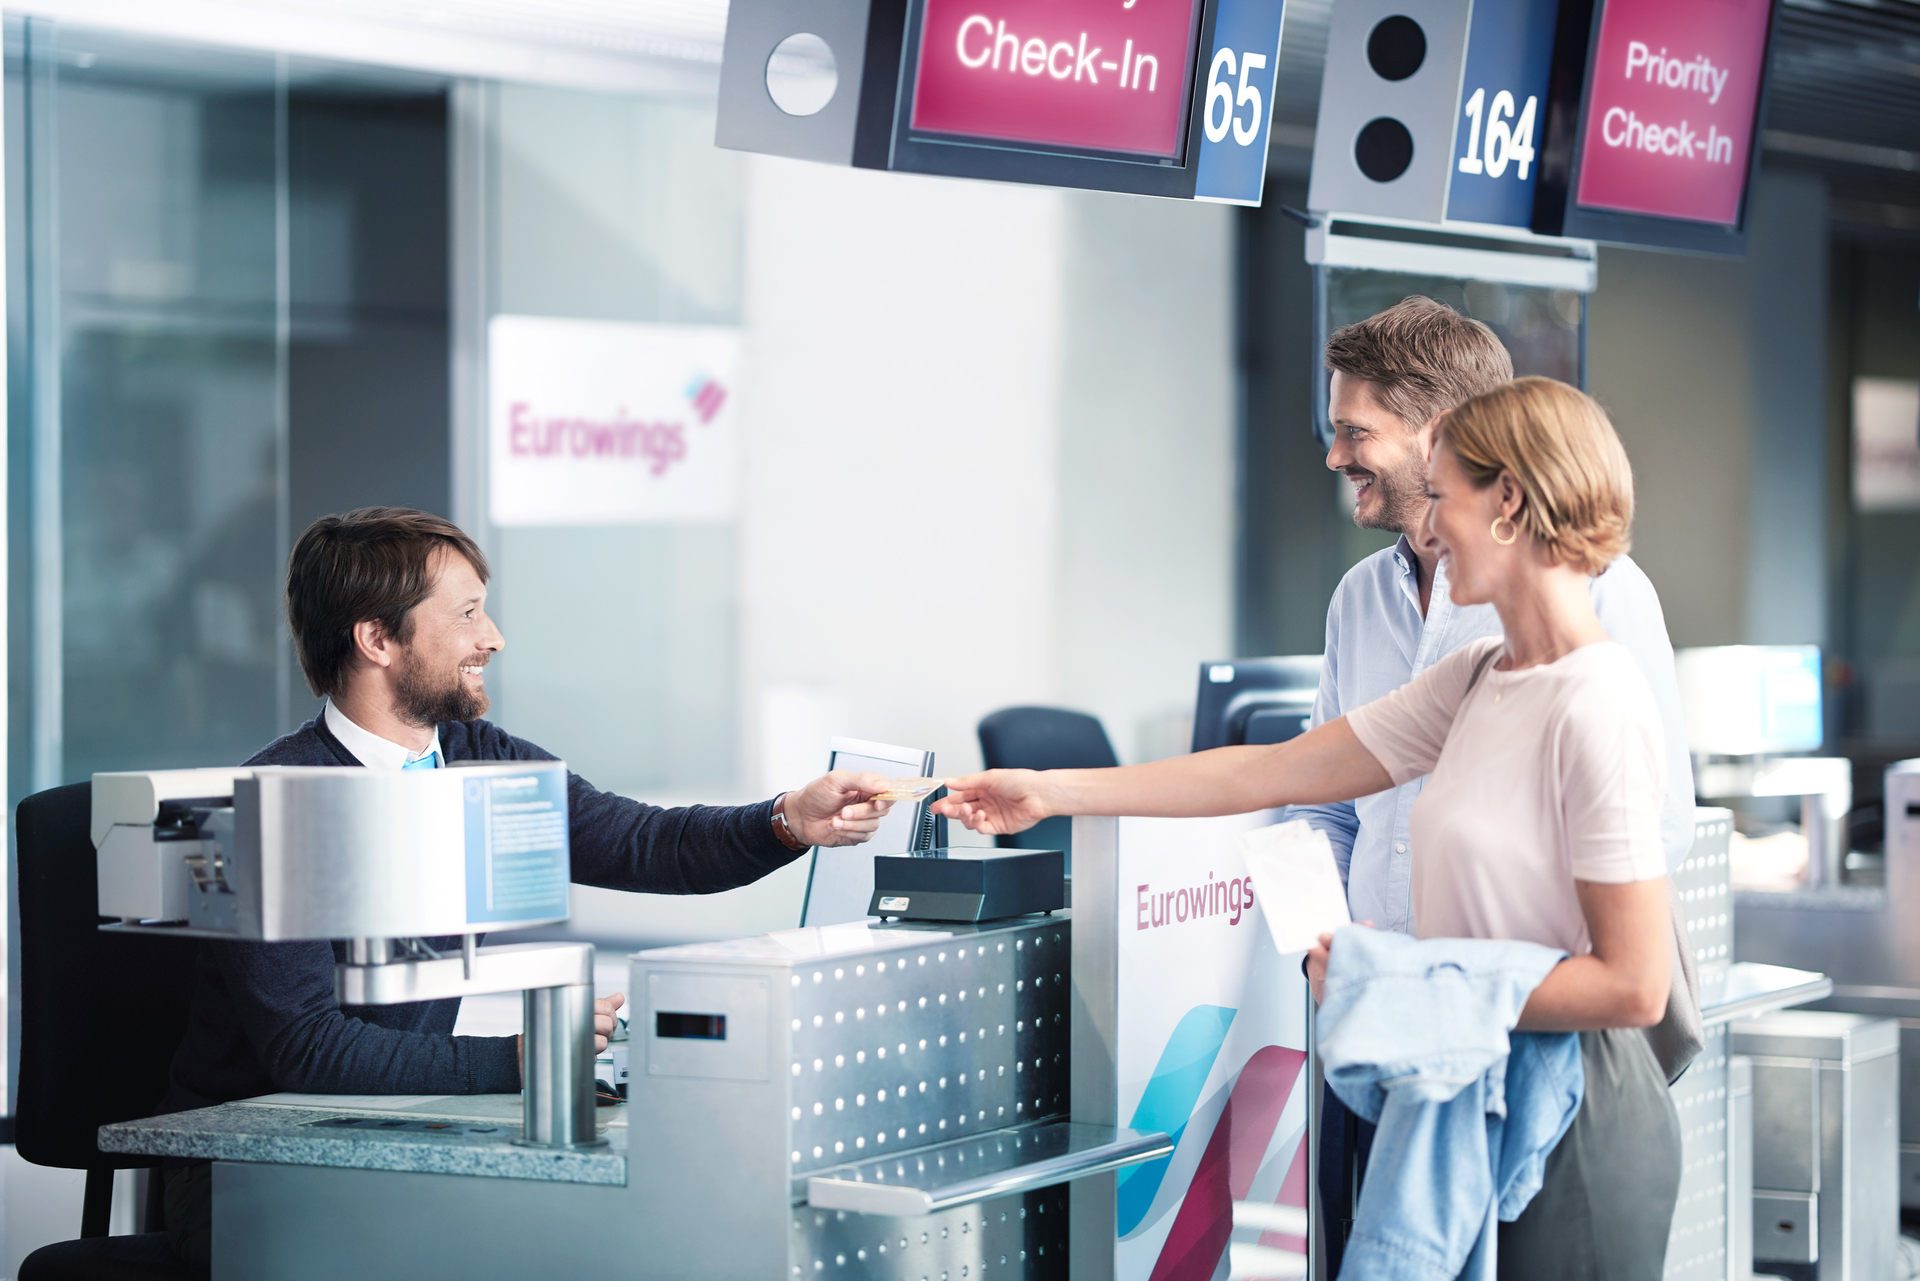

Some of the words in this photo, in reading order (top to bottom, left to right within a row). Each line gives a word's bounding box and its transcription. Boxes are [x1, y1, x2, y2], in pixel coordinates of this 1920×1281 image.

[957, 15, 1158, 91] Check-In
[1626, 42, 1728, 104] Priority
[1204, 47, 1267, 146] 65
[1459, 88, 1537, 180] 164
[1602, 107, 1732, 164] Check-In
[509, 401, 687, 477] Eurowings
[1137, 870, 1254, 931] Eurowings
